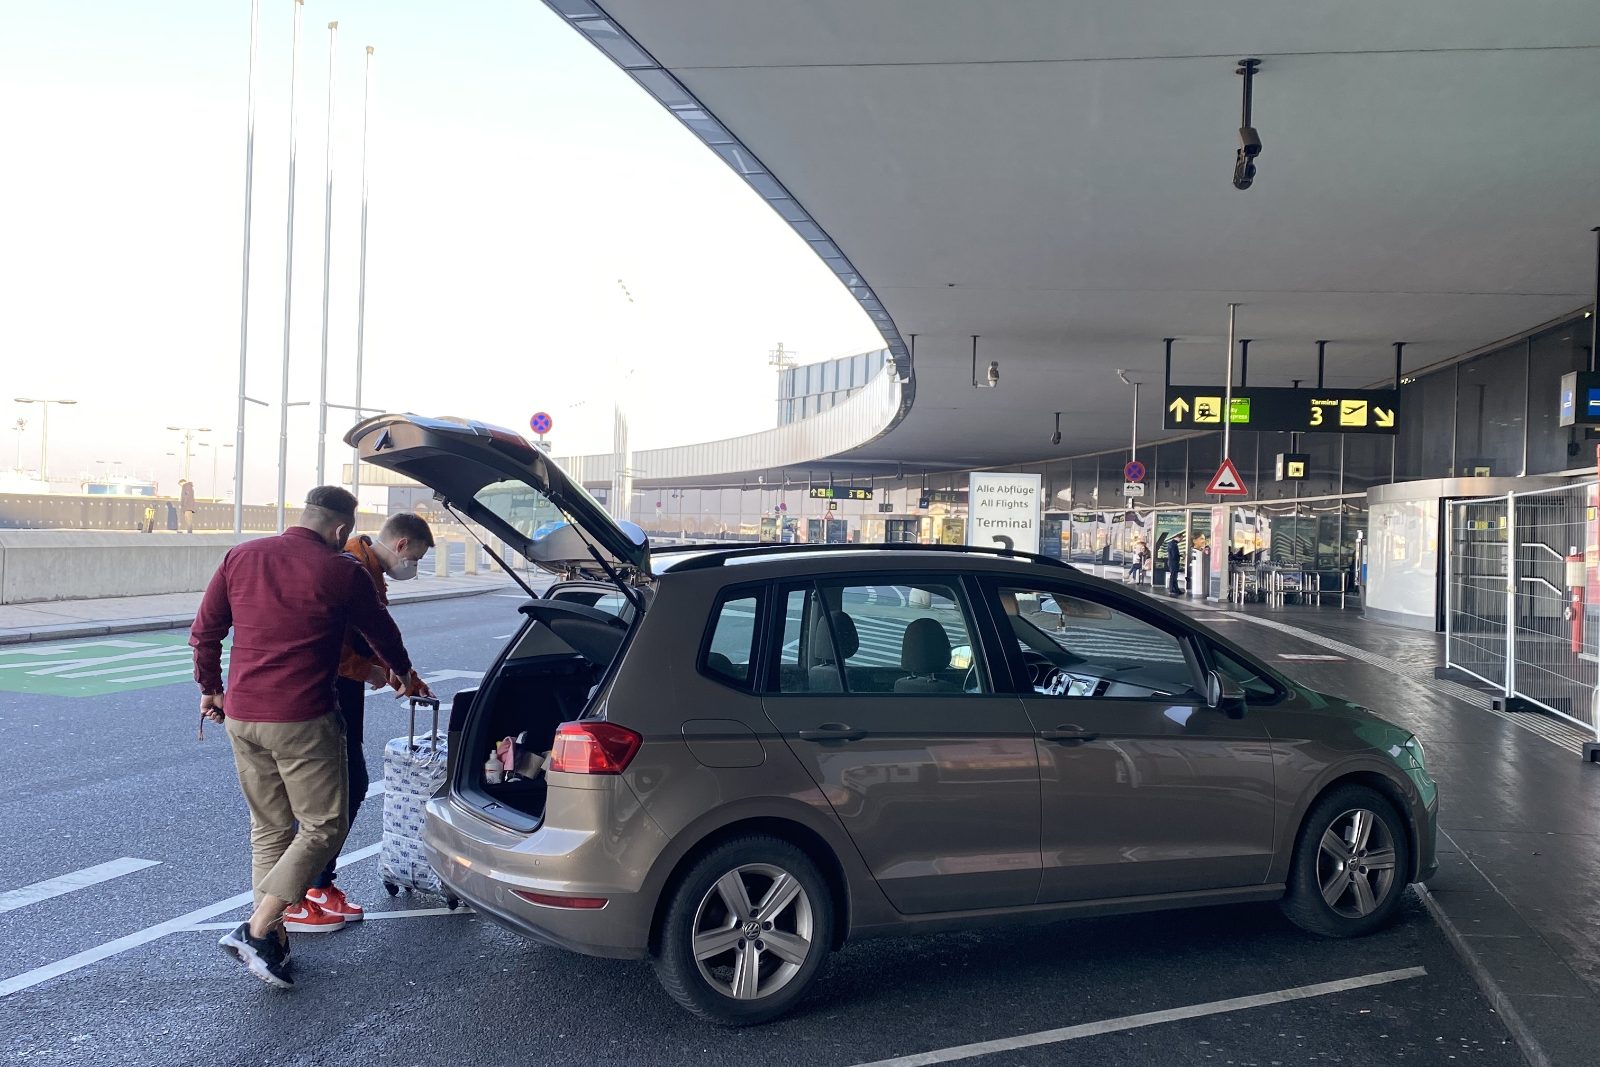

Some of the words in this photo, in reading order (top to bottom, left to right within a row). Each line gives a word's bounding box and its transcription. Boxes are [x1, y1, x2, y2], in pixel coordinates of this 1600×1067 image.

[1310, 406, 1322, 426] 3
[976, 484, 994, 492] Alle
[996, 485, 1034, 496] Abflüge
[996, 500, 1029, 509] Flights
[976, 517, 1032, 528] Terminal
